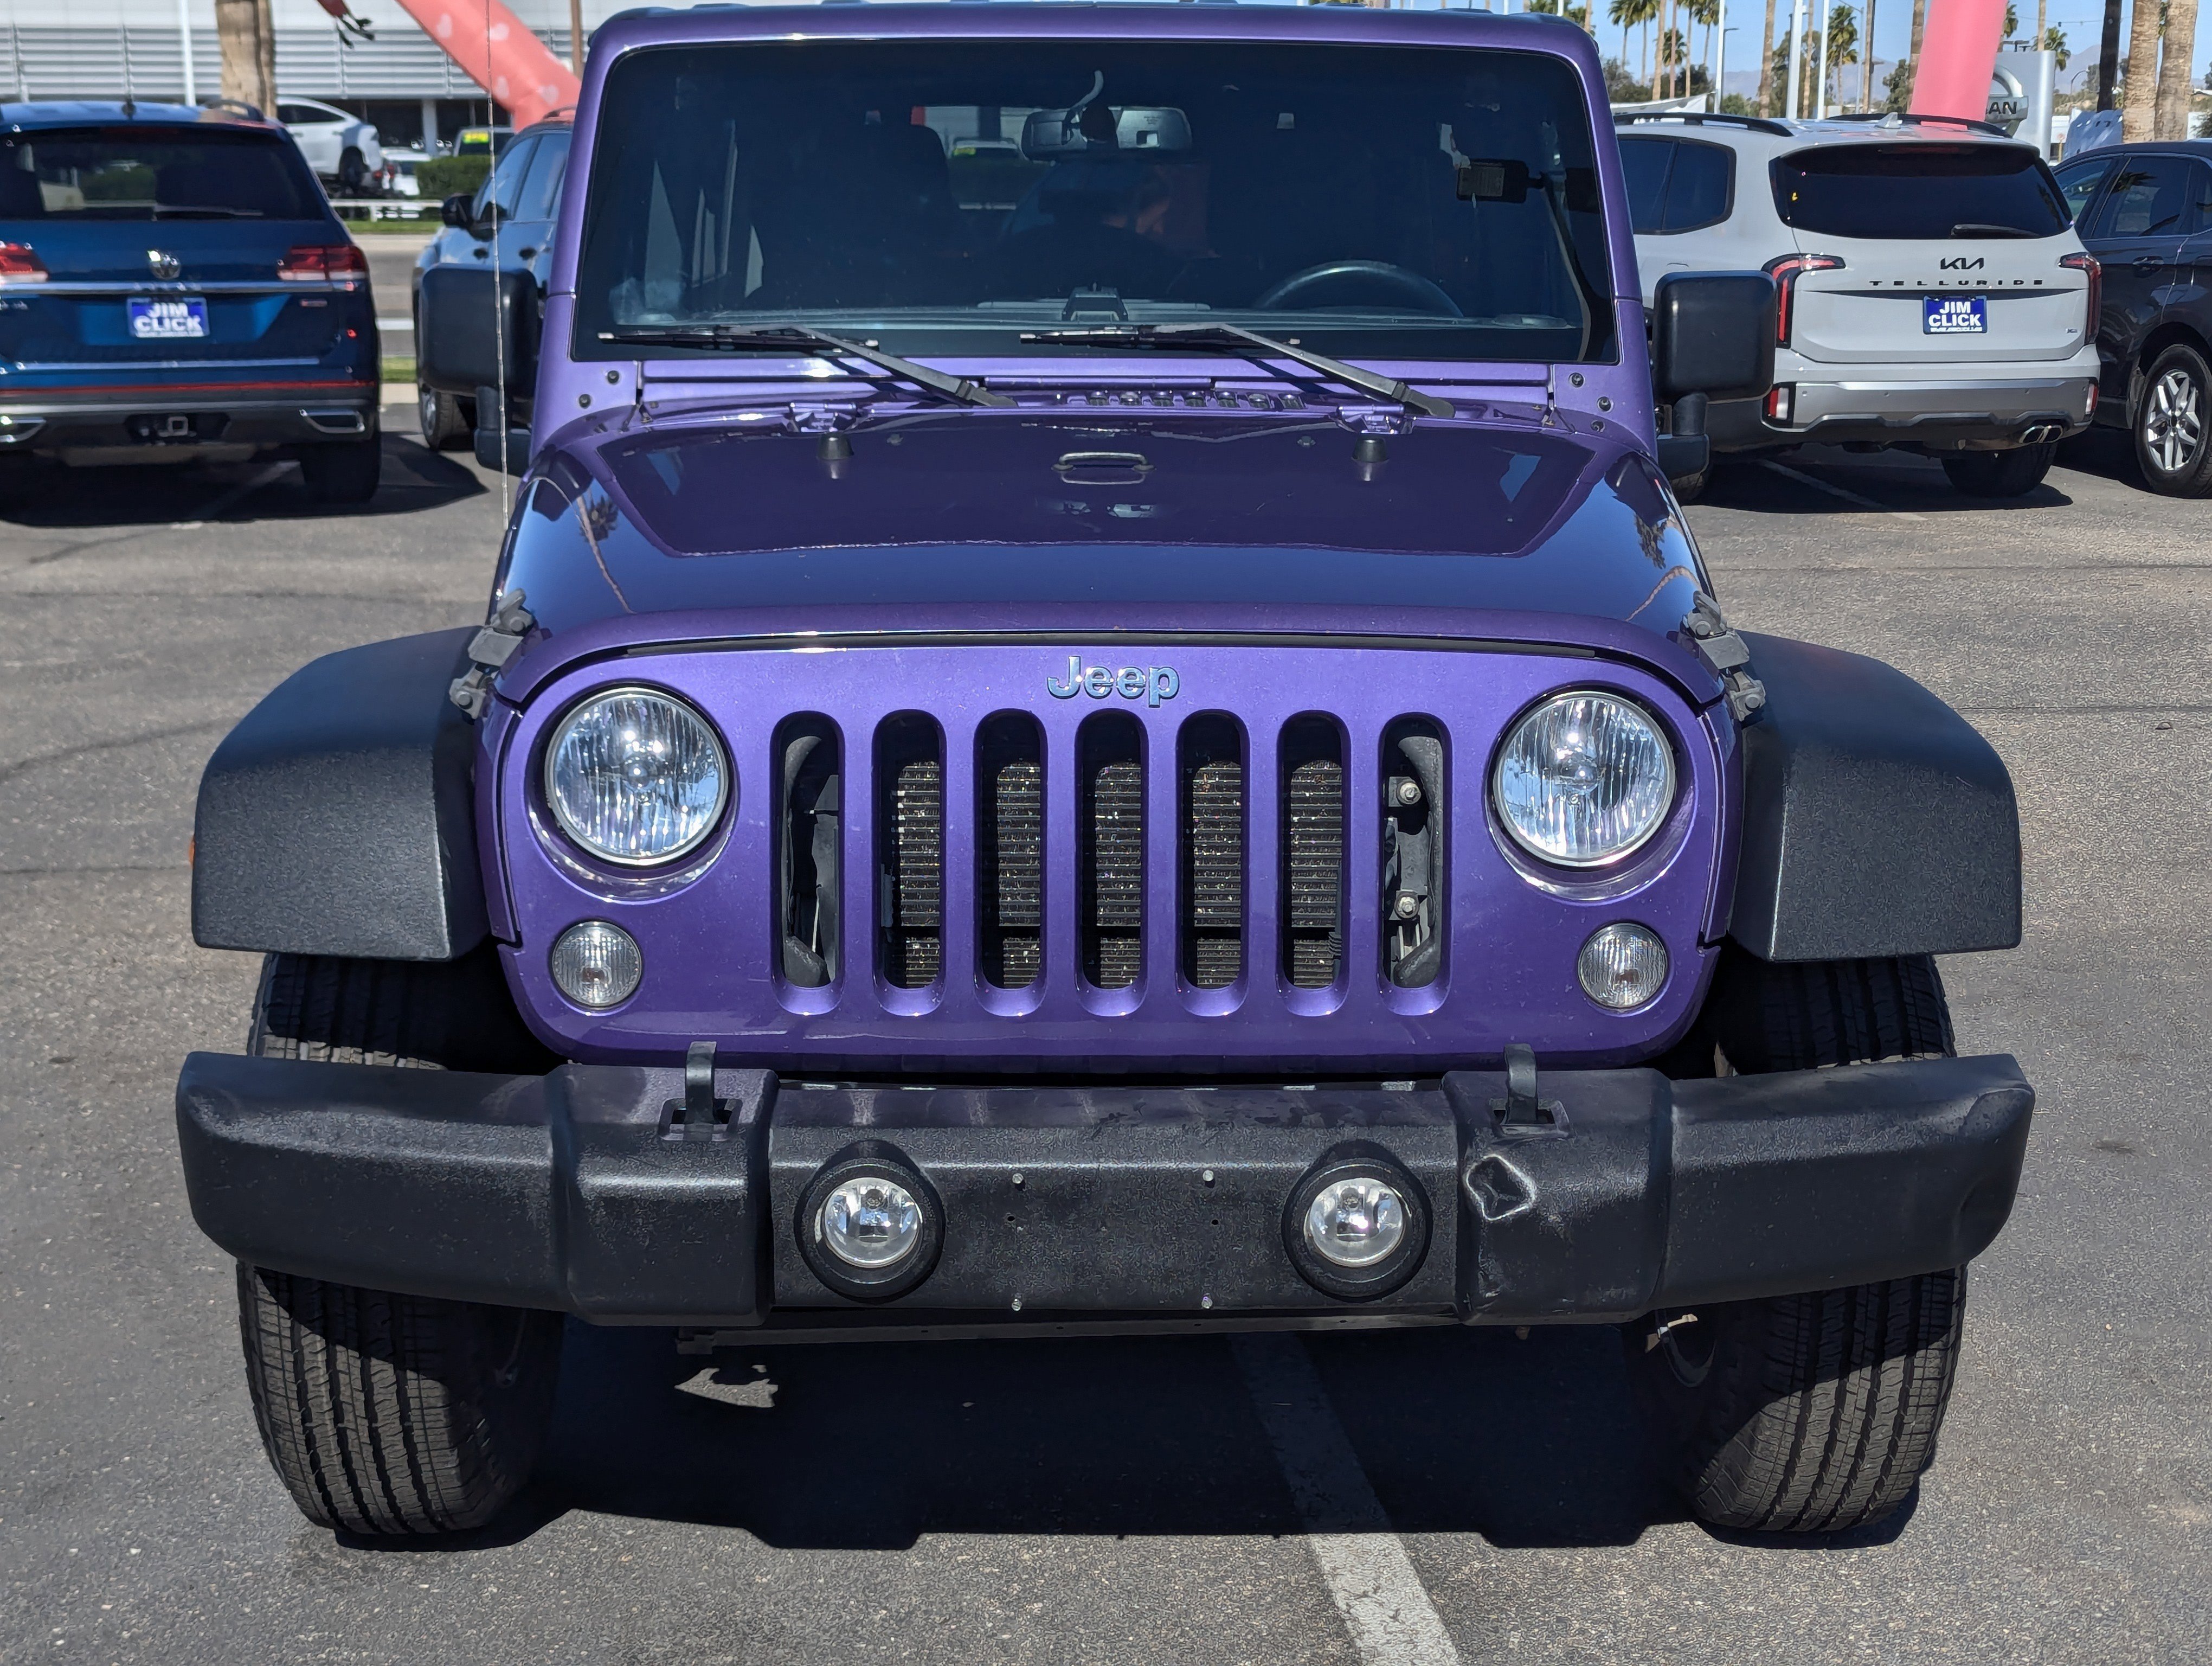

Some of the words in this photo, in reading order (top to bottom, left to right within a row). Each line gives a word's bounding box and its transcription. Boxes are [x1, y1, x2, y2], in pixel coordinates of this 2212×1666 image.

[1940, 258, 1984, 270] KIA
[147, 303, 188, 317] JIM
[1939, 302, 1971, 313] JIM
[133, 315, 203, 331] CLICK
[1928, 314, 1981, 326] CLICK
[1047, 655, 1180, 708] Jeep
